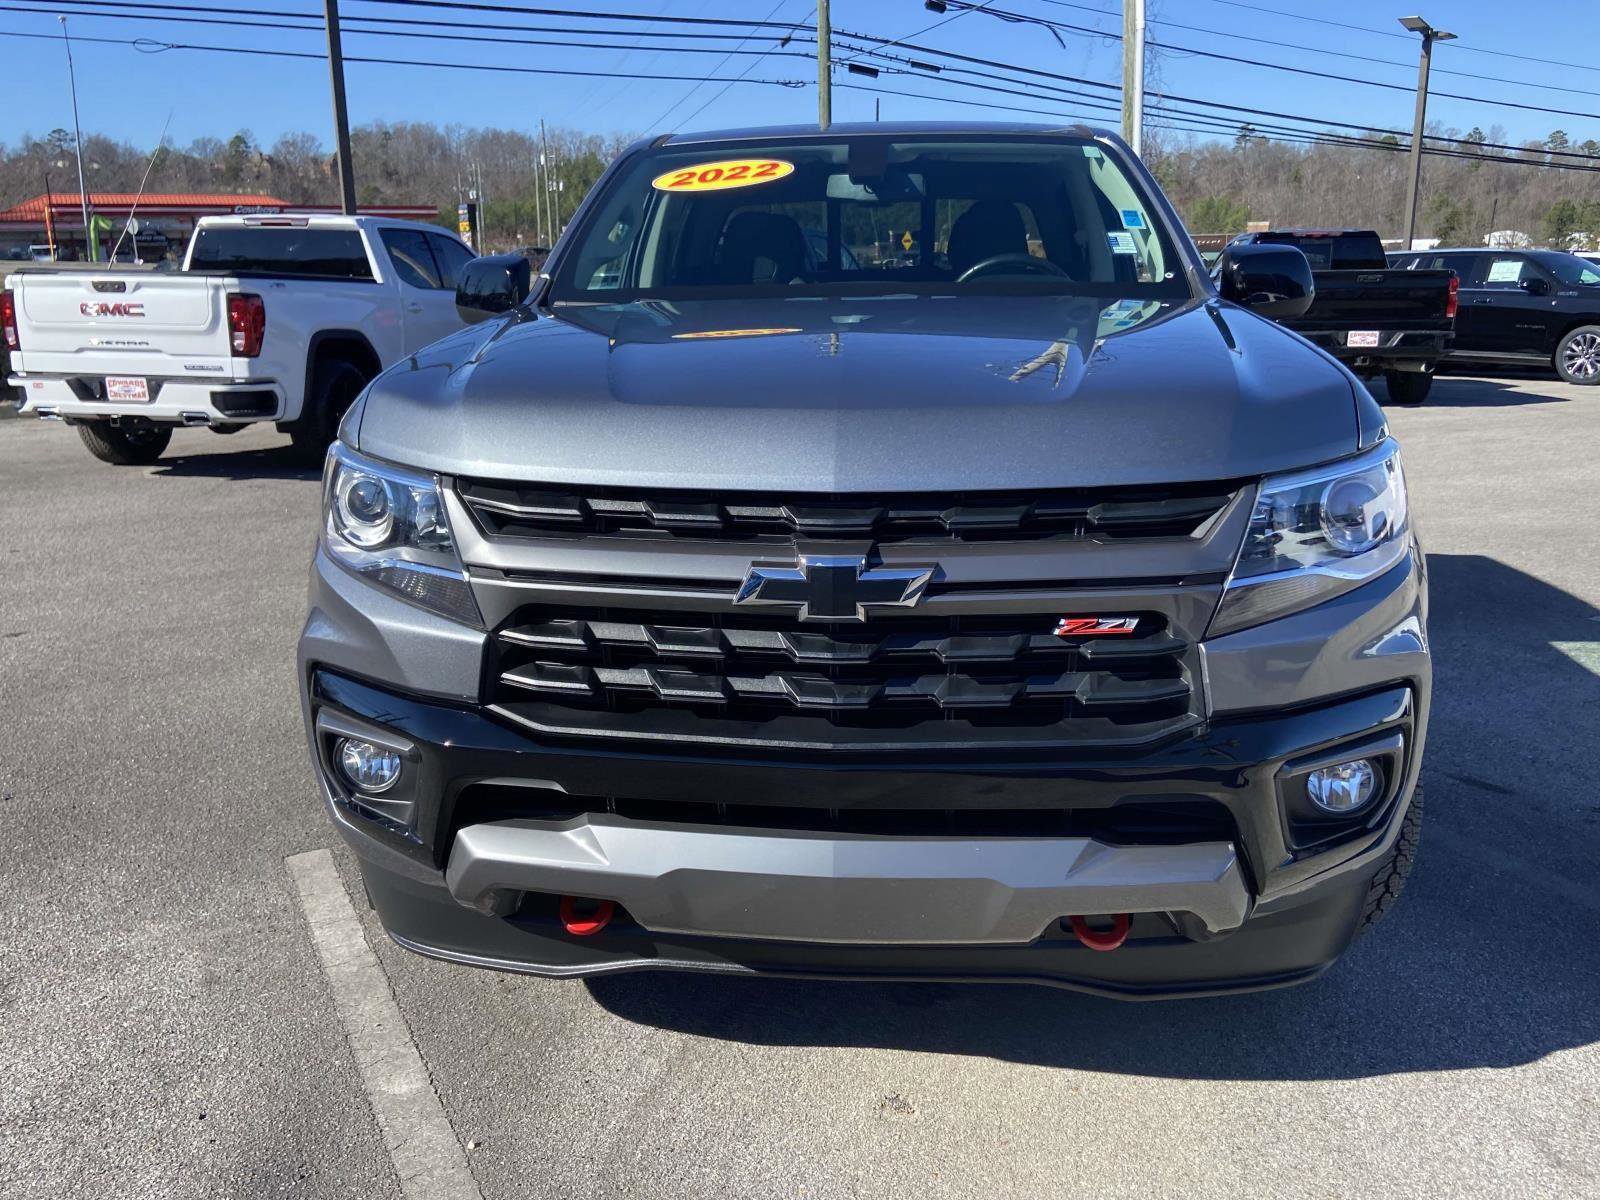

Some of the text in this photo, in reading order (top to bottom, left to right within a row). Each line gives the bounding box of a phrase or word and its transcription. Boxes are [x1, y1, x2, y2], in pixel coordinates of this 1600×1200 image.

[668, 163, 780, 188] 2022
[80, 303, 146, 317] GMC
[88, 338, 150, 346] IERRA
[108, 380, 145, 388] EDWARDS
[1053, 618, 1140, 635] Z71
